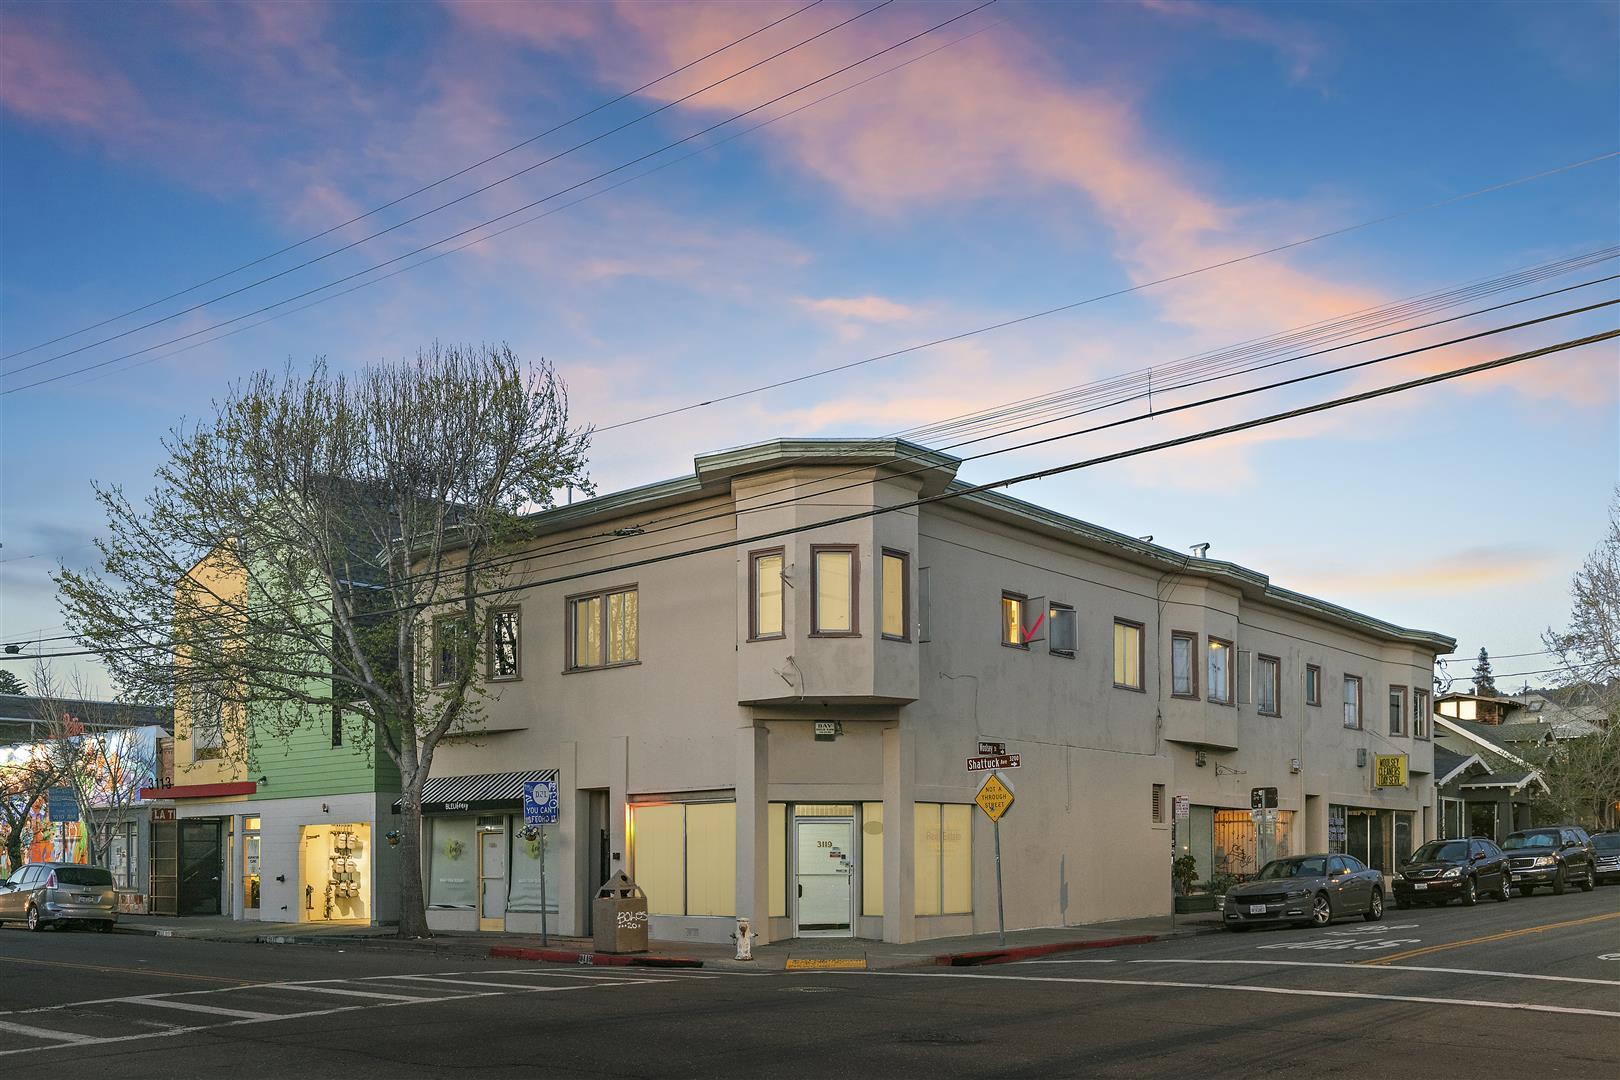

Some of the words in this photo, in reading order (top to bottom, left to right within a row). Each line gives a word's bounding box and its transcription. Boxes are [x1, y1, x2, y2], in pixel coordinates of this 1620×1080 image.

[968, 757, 1000, 770] Shattuck
[1379, 758, 1399, 767] WOOLSEY
[1378, 767, 1400, 775] CLEANERS
[149, 777, 171, 789] 3113
[981, 794, 1007, 802] THROUGH
[155, 810, 165, 819] LA
[526, 806, 539, 815] YOU
[816, 840, 833, 848] 3119
